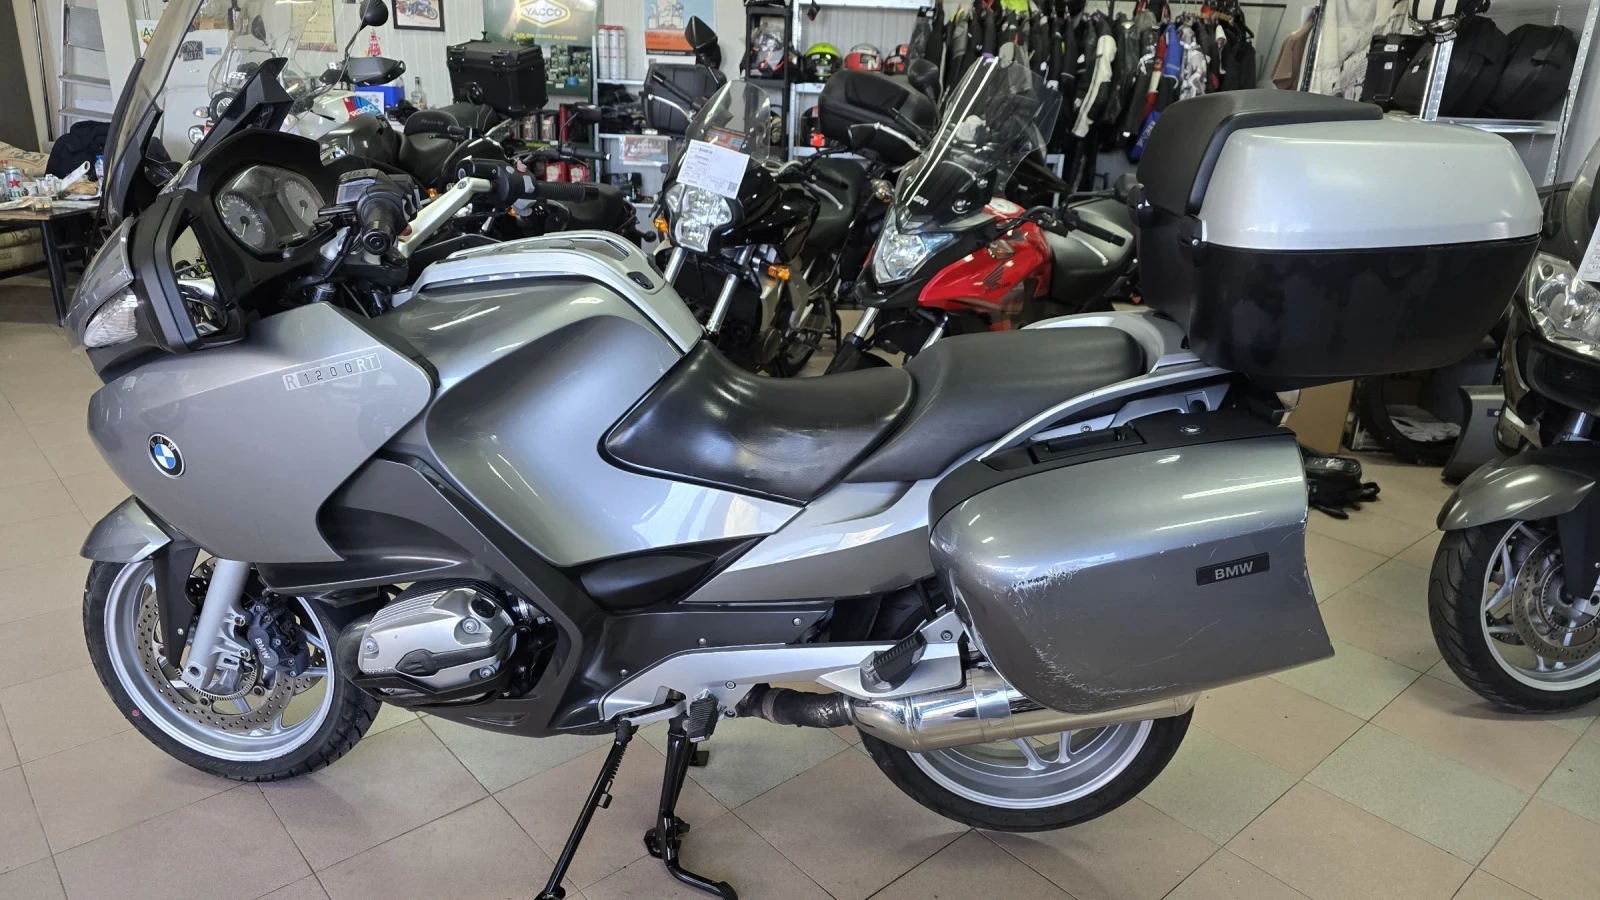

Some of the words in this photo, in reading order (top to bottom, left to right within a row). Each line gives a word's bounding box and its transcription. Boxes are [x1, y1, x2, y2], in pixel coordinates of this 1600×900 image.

[524, 7, 563, 17] YACCO
[228, 71, 247, 80] GS
[913, 195, 930, 207] GIVI
[150, 435, 176, 451] BMW
[1214, 561, 1254, 580] BMW
[255, 637, 271, 659] BMW
